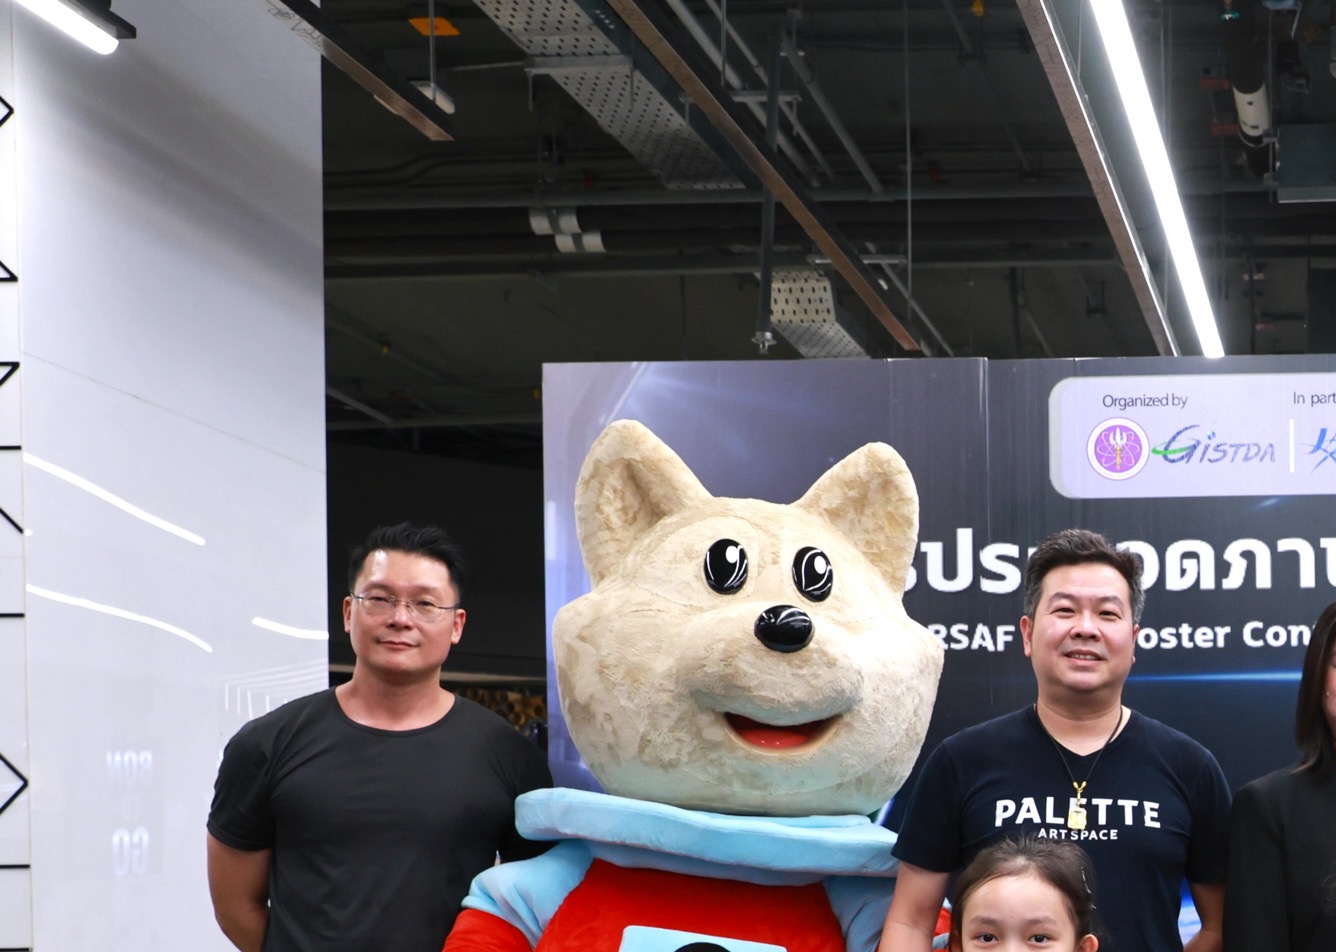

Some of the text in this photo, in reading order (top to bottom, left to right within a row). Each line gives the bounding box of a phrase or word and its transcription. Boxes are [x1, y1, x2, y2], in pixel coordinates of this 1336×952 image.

[1102, 393, 1188, 411] Organized by
[1293, 391, 1306, 405] In
[927, 622, 1015, 652] RSAF
[1136, 623, 1231, 650] oster
[1242, 620, 1314, 647] Con
